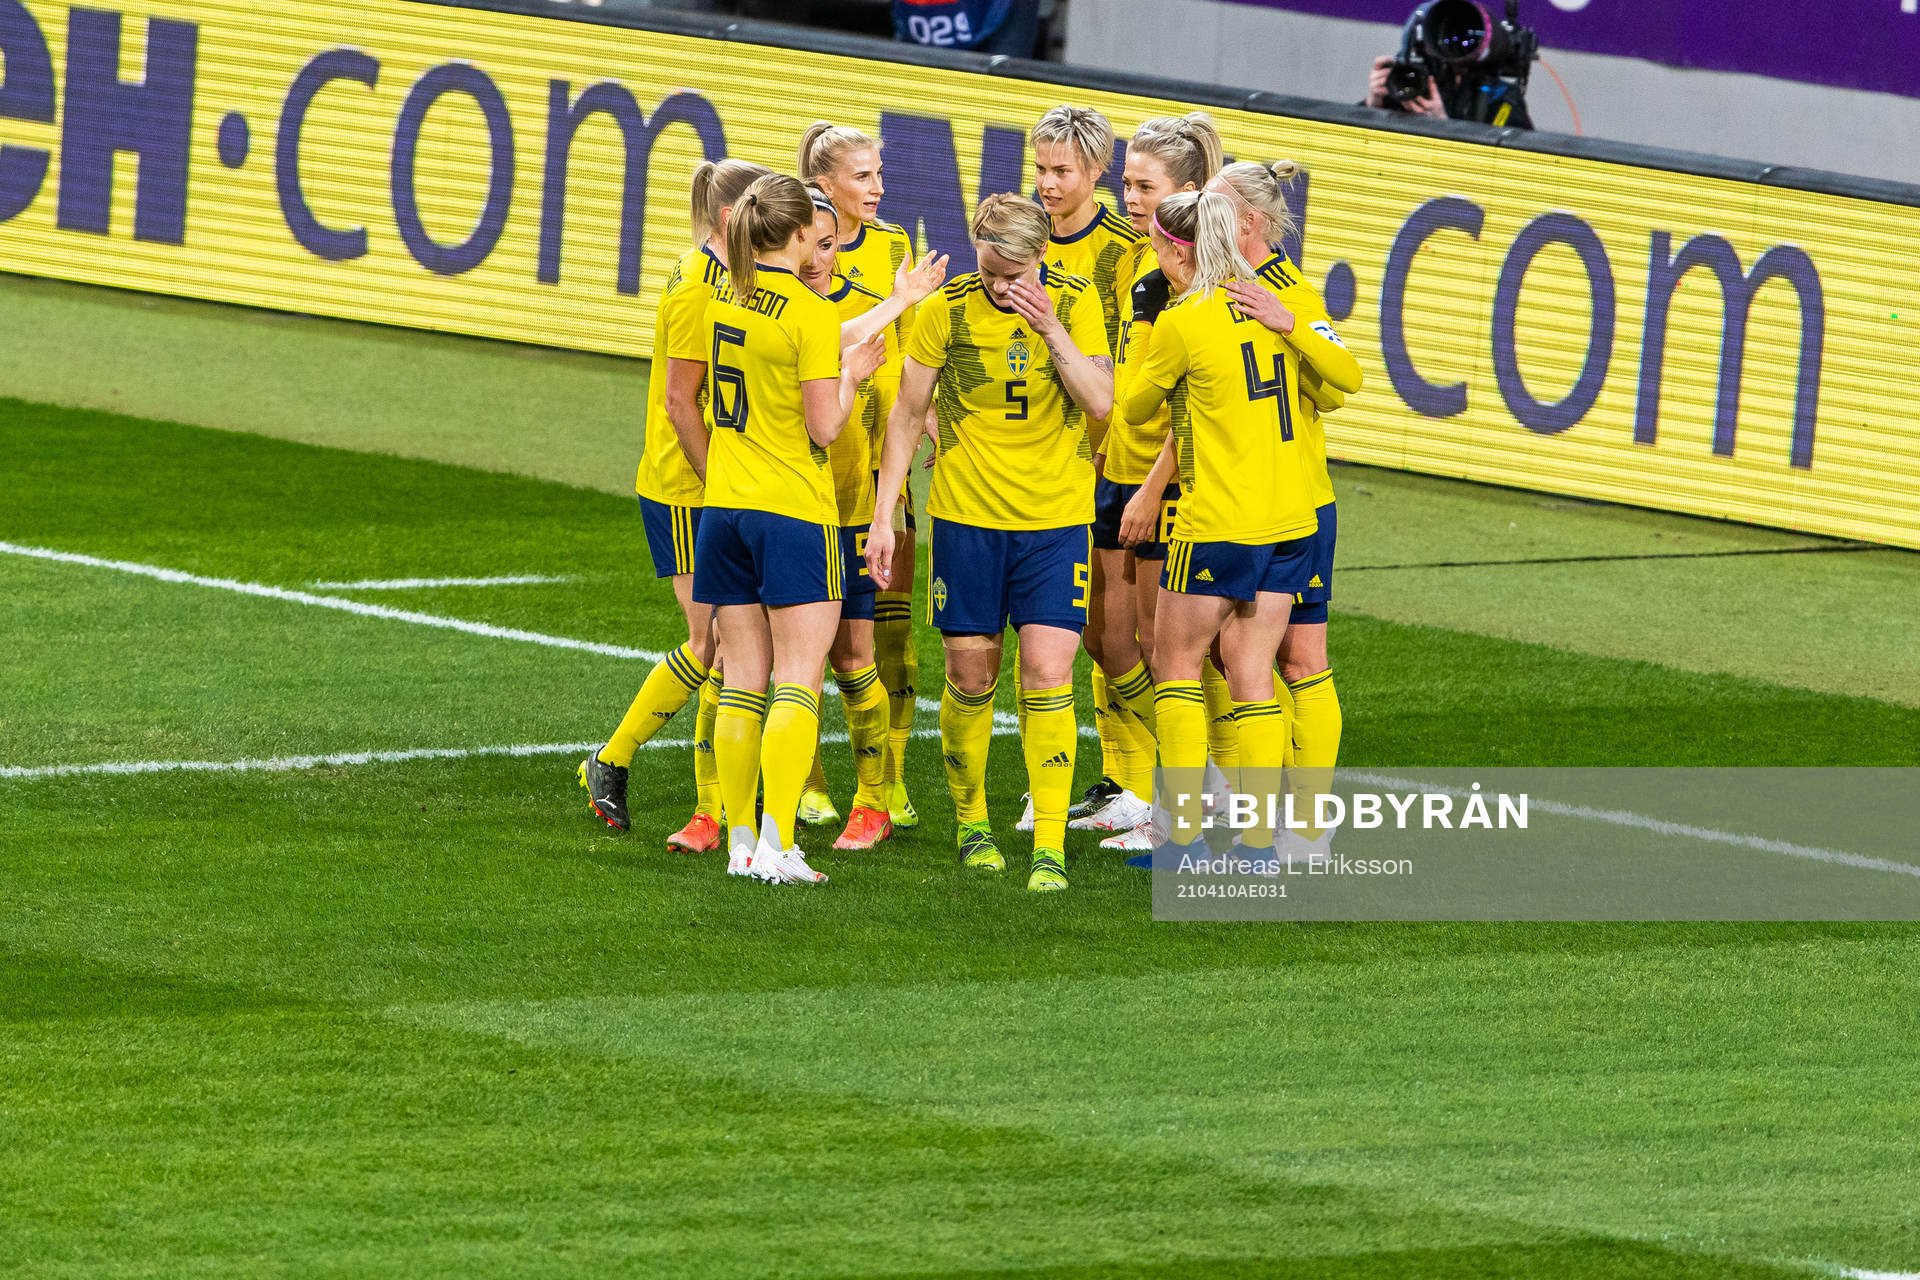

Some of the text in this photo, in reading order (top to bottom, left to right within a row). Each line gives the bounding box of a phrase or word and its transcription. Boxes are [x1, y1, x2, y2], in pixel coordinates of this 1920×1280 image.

[712, 321, 749, 433] 6
[1005, 380, 1028, 420] 5
[1240, 341, 1294, 442] 4
[1072, 562, 1088, 608] 5
